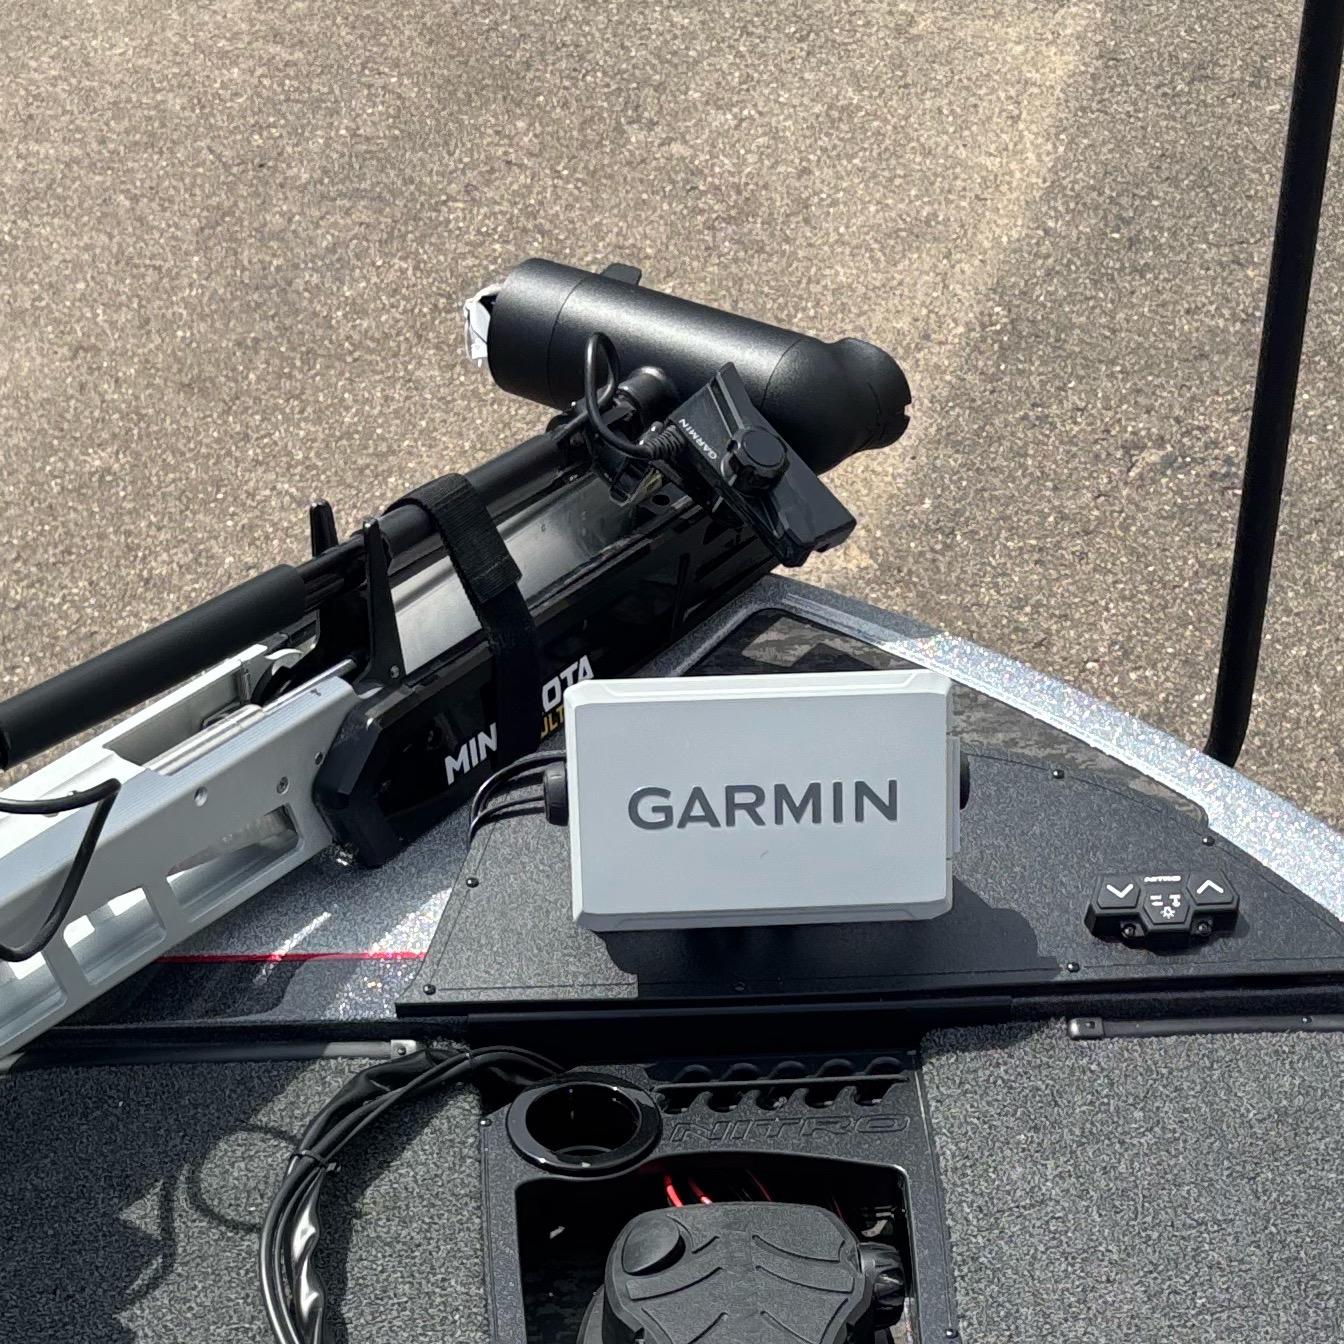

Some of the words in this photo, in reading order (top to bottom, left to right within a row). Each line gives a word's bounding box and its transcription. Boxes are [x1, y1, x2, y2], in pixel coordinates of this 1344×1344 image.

[678, 418, 718, 460] GARMIN
[444, 721, 498, 786] MIN
[541, 654, 595, 713] OTA
[627, 778, 898, 830] GARMIN
[669, 1113, 911, 1143] NITRO
